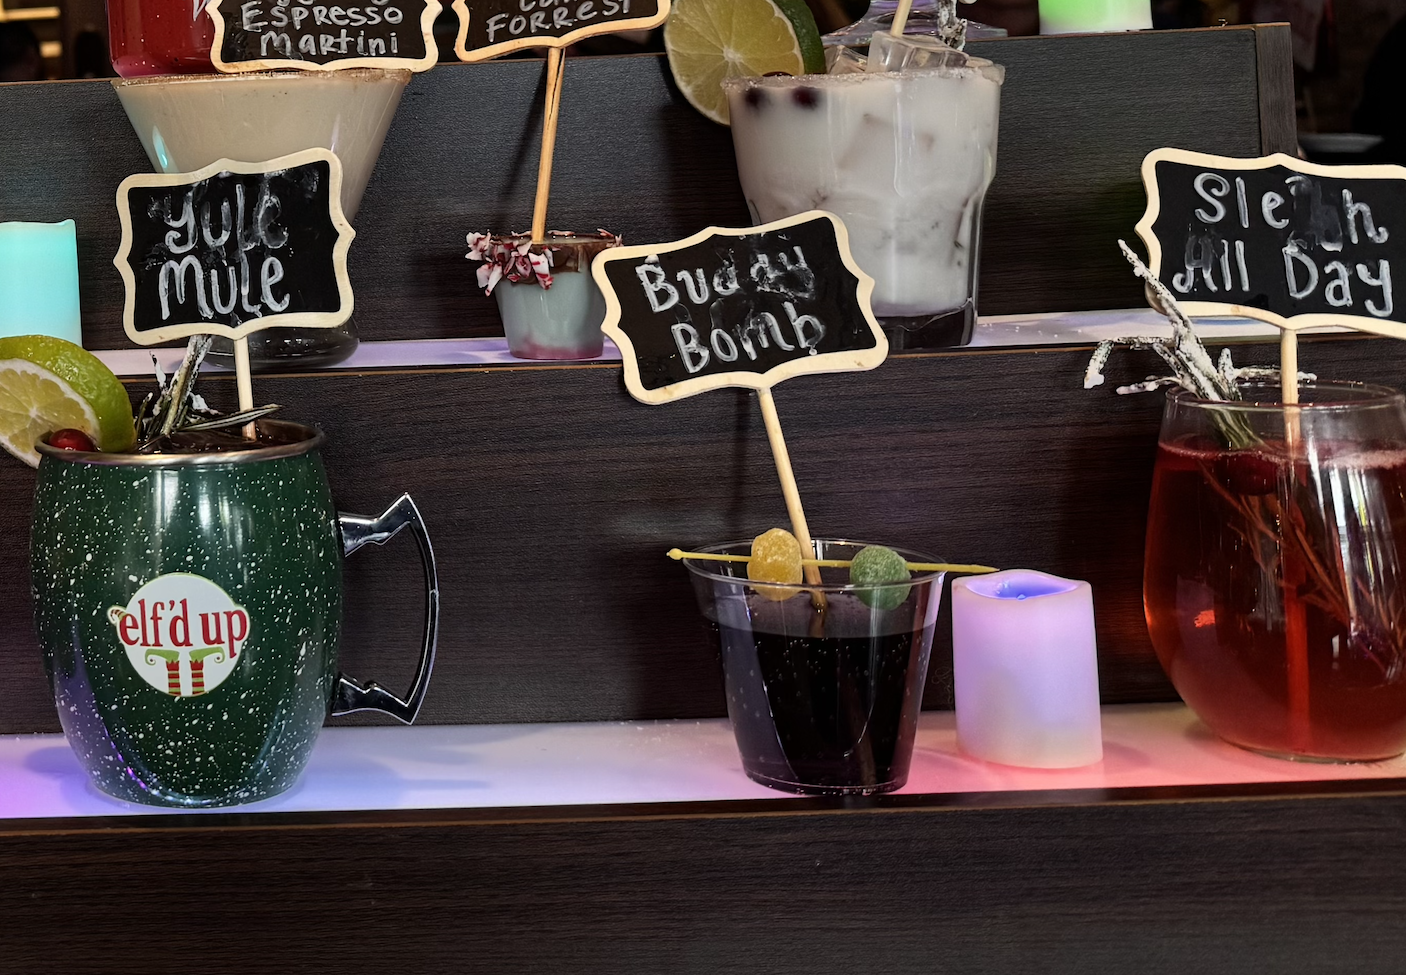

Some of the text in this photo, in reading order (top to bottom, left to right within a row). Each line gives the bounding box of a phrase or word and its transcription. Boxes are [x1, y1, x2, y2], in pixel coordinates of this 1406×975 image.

[159, 255, 290, 320] Mule
[1282, 242, 1393, 317] Day
[671, 301, 826, 373] Bomb
[119, 598, 248, 659] elf'd up
